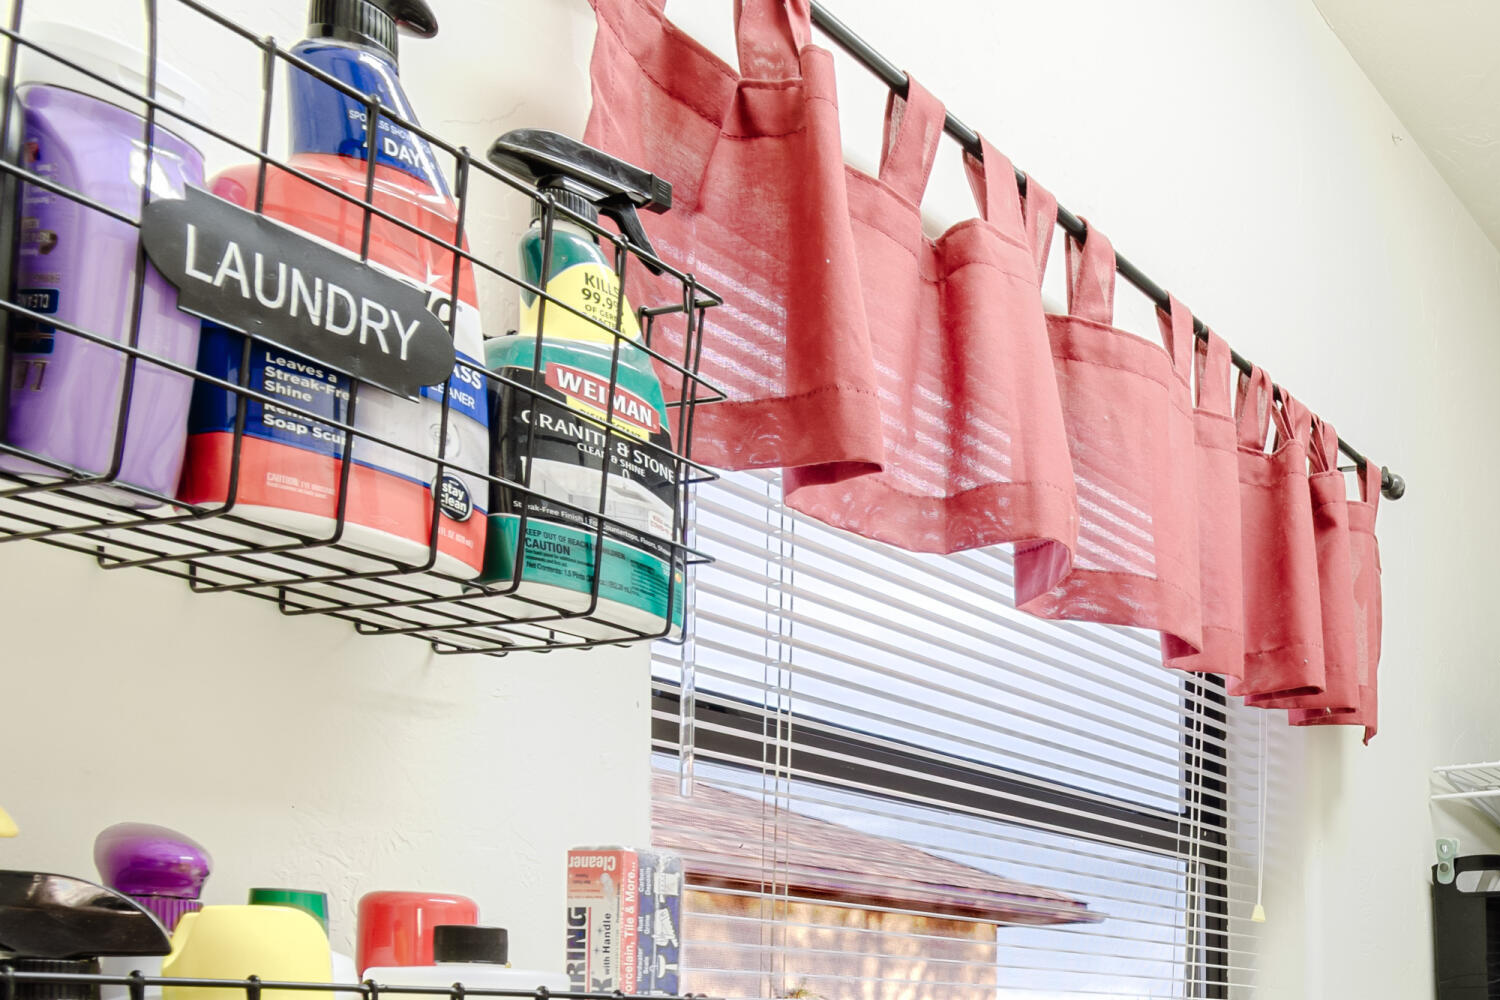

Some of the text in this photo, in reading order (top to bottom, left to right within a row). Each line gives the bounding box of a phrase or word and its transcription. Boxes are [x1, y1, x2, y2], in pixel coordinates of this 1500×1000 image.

[185, 223, 421, 361] LAUNDRY
[265, 351, 338, 383] Leaves a
[264, 380, 313, 402] Shine
[430, 382, 476, 410] EANER
[555, 367, 653, 427] WEIMAN
[263, 413, 309, 435] Soap
[520, 409, 612, 449] GRANIT
[616, 442, 630, 458] &
[633, 450, 676, 485] STONE
[619, 459, 646, 478] SHINE
[441, 483, 464, 502] stay
[525, 538, 571, 556] CAUTION
[602, 913, 612, 953] Handle
[624, 923, 635, 939] Tile
[623, 941, 635, 992] orcelain,
